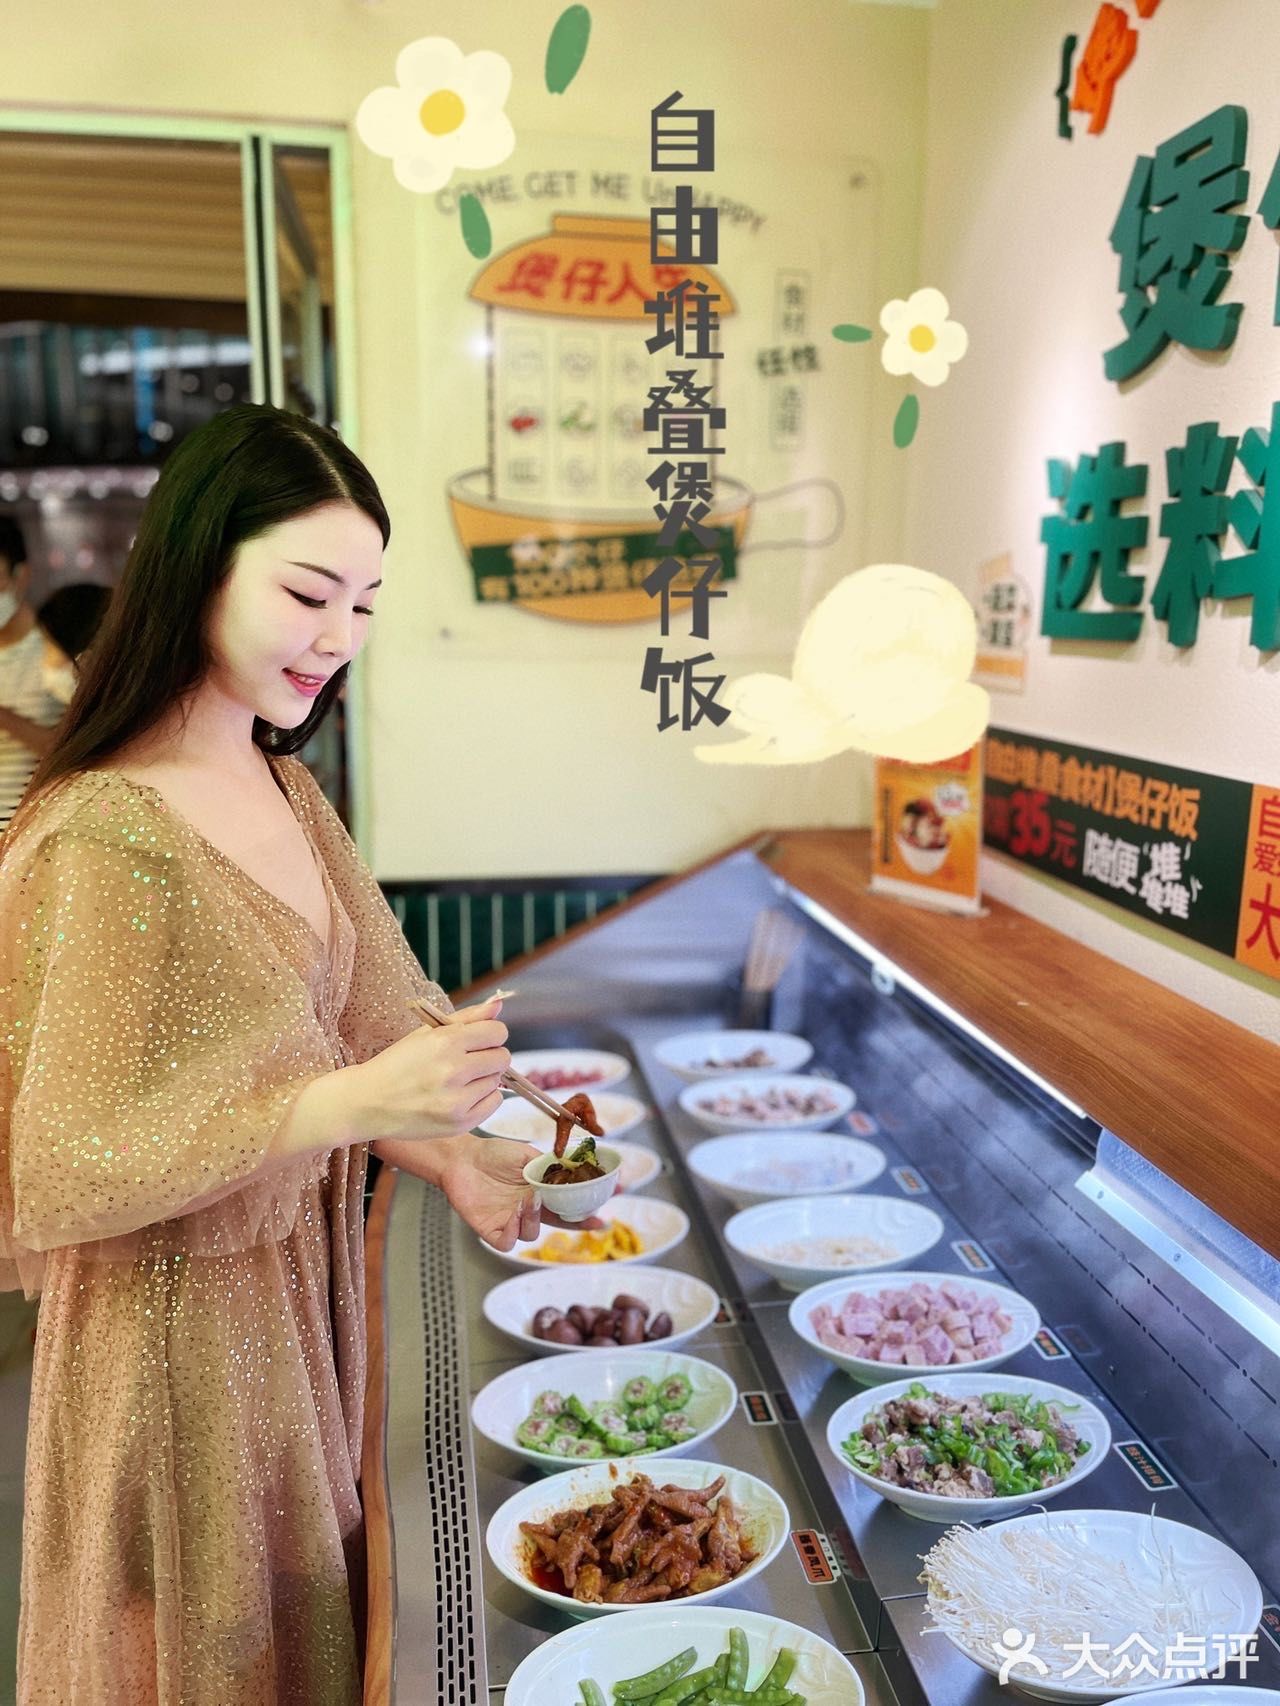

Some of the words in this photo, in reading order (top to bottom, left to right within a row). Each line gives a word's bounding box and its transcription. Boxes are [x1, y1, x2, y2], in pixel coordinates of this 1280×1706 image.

[523, 170, 578, 200] GET
[590, 172, 631, 200] ME
[1039, 401, 1280, 655] 选料
